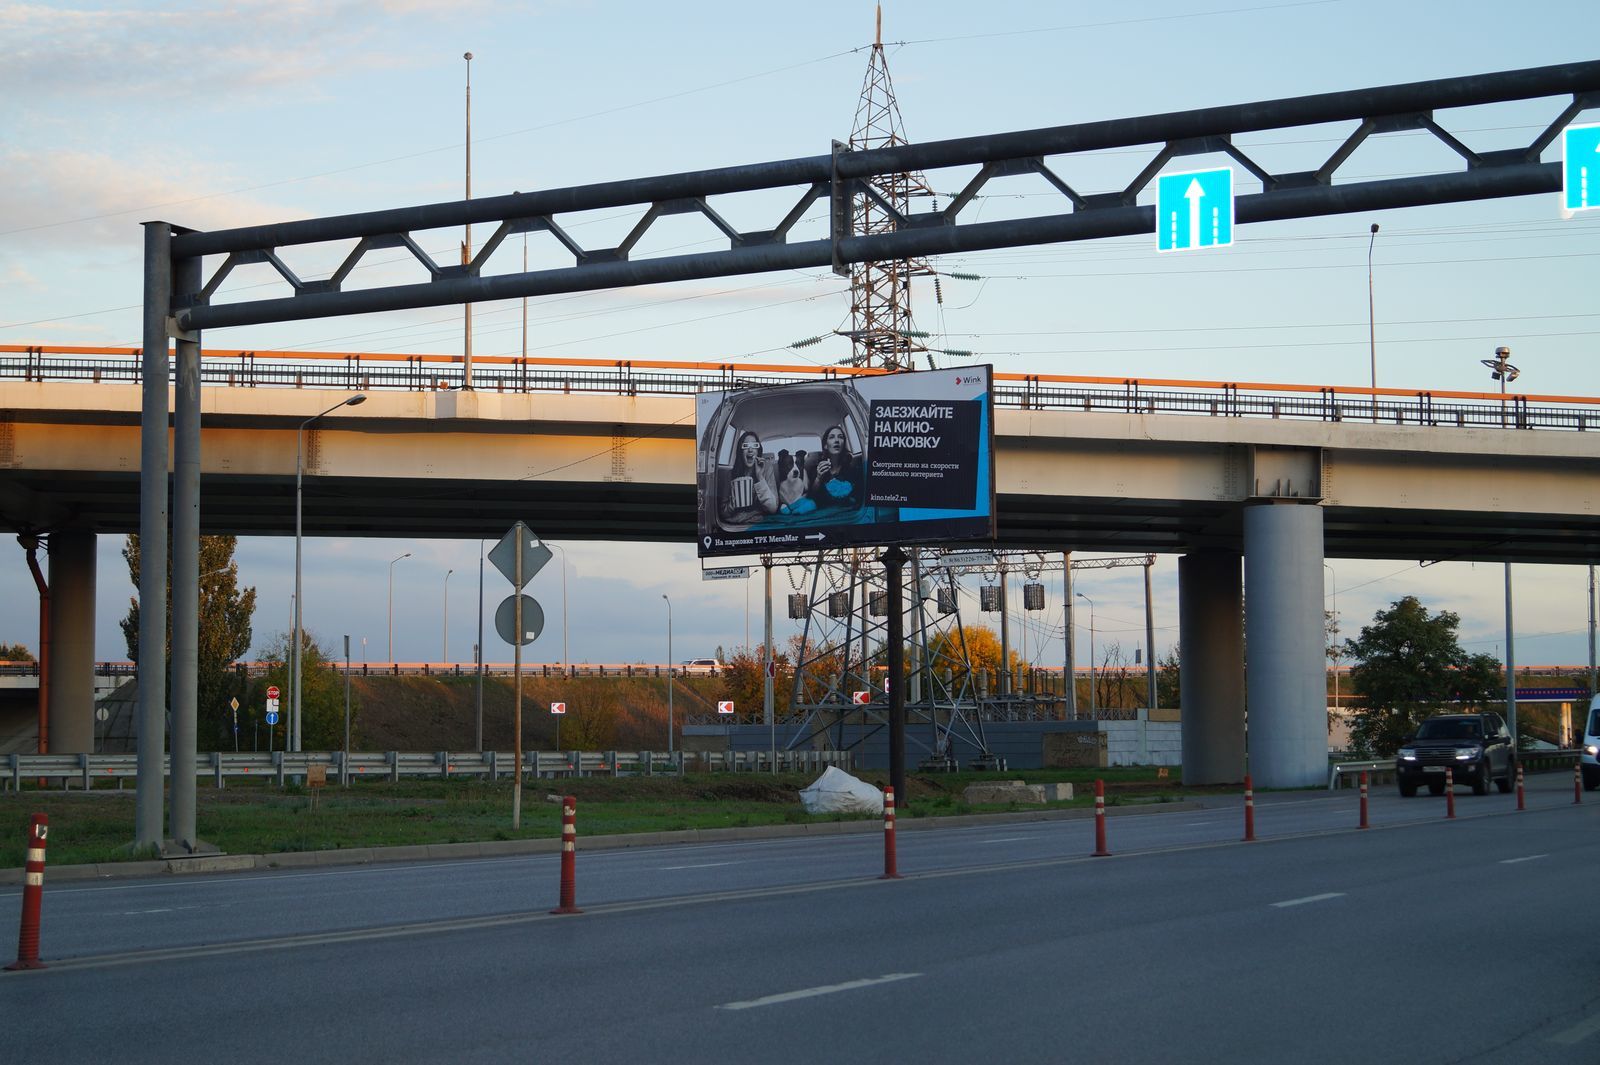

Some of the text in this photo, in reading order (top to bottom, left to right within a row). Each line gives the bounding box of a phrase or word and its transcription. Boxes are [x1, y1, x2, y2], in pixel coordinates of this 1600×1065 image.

[963, 376, 982, 384] Wink
[875, 404, 954, 419] ЗАЕЗЖАЙТЕ
[874, 421, 934, 434] НА КИНО-
[873, 436, 941, 449] ПАРКОВКУ
[872, 461, 903, 469] Смотрите
[872, 469, 944, 479] мобильного интернета
[870, 493, 908, 502] kino.tele2.ru
[724, 538, 754, 547] парковке
[754, 536, 768, 544] ТРК
[768, 534, 799, 543] МегаМаг
